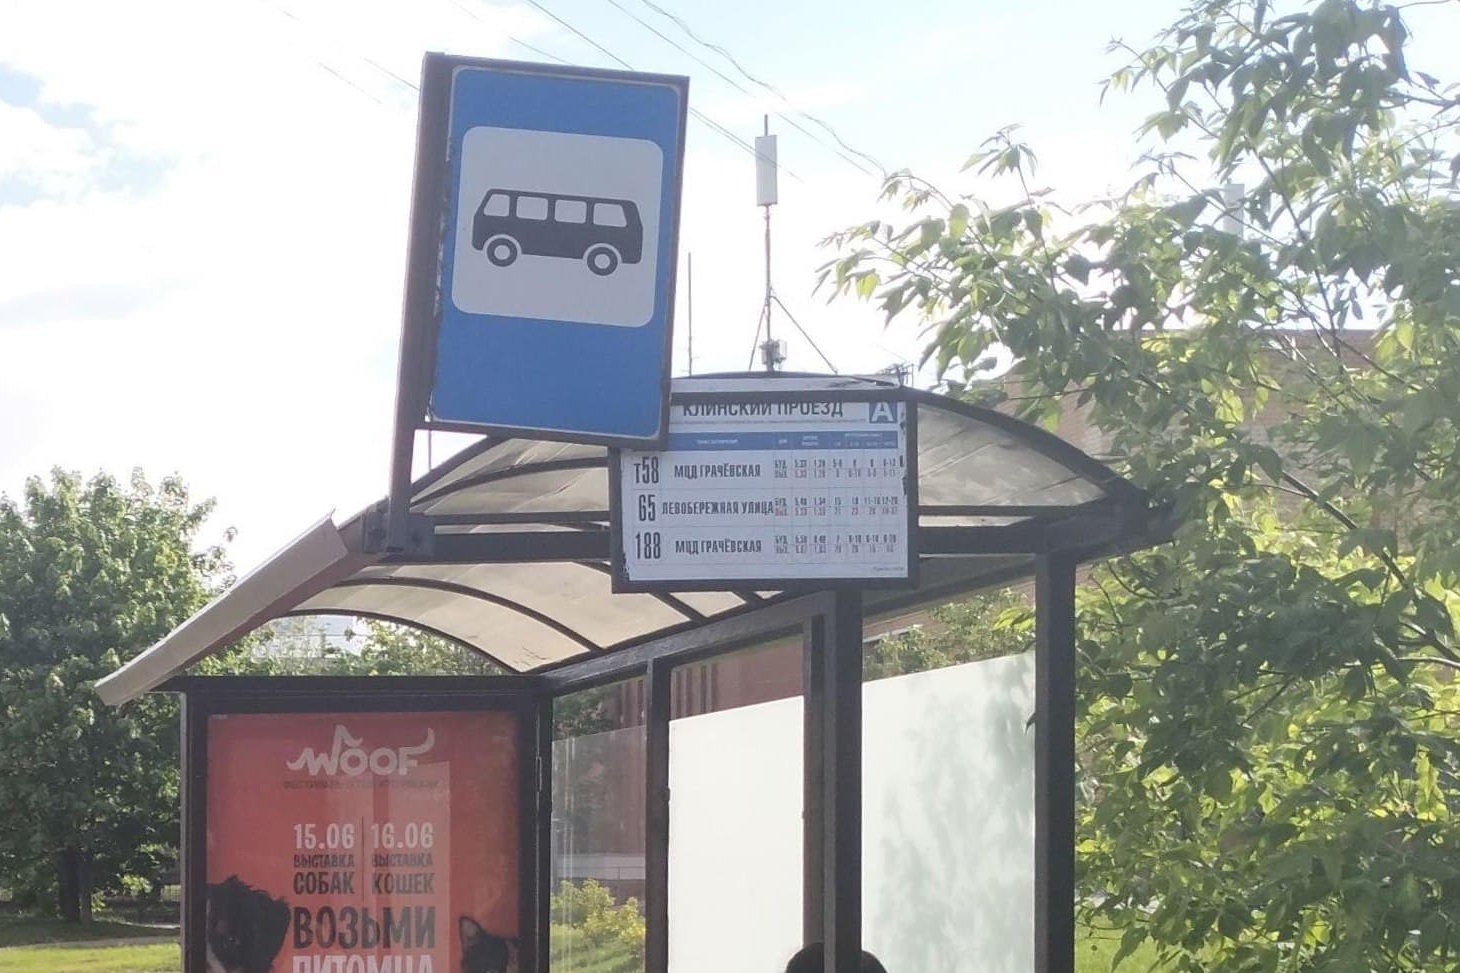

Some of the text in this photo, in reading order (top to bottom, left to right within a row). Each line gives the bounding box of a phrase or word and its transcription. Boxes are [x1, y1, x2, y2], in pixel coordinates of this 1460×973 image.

[778, 401, 843, 417] ПРОЕЗД
[674, 464, 698, 480] МЦД
[638, 494, 656, 521] 65
[741, 501, 774, 516] УЛИЦА
[635, 532, 661, 559] 188
[675, 540, 699, 555] МЦД
[293, 823, 356, 849] 15.06
[371, 822, 435, 849] 16.06
[293, 854, 355, 868] ВЫСТАВКА
[371, 853, 434, 868] ВЫСТАВКА
[293, 871, 355, 895] СОБАК
[371, 872, 435, 894] КОШЕК
[293, 906, 436, 949] ВОЗЬМИ
